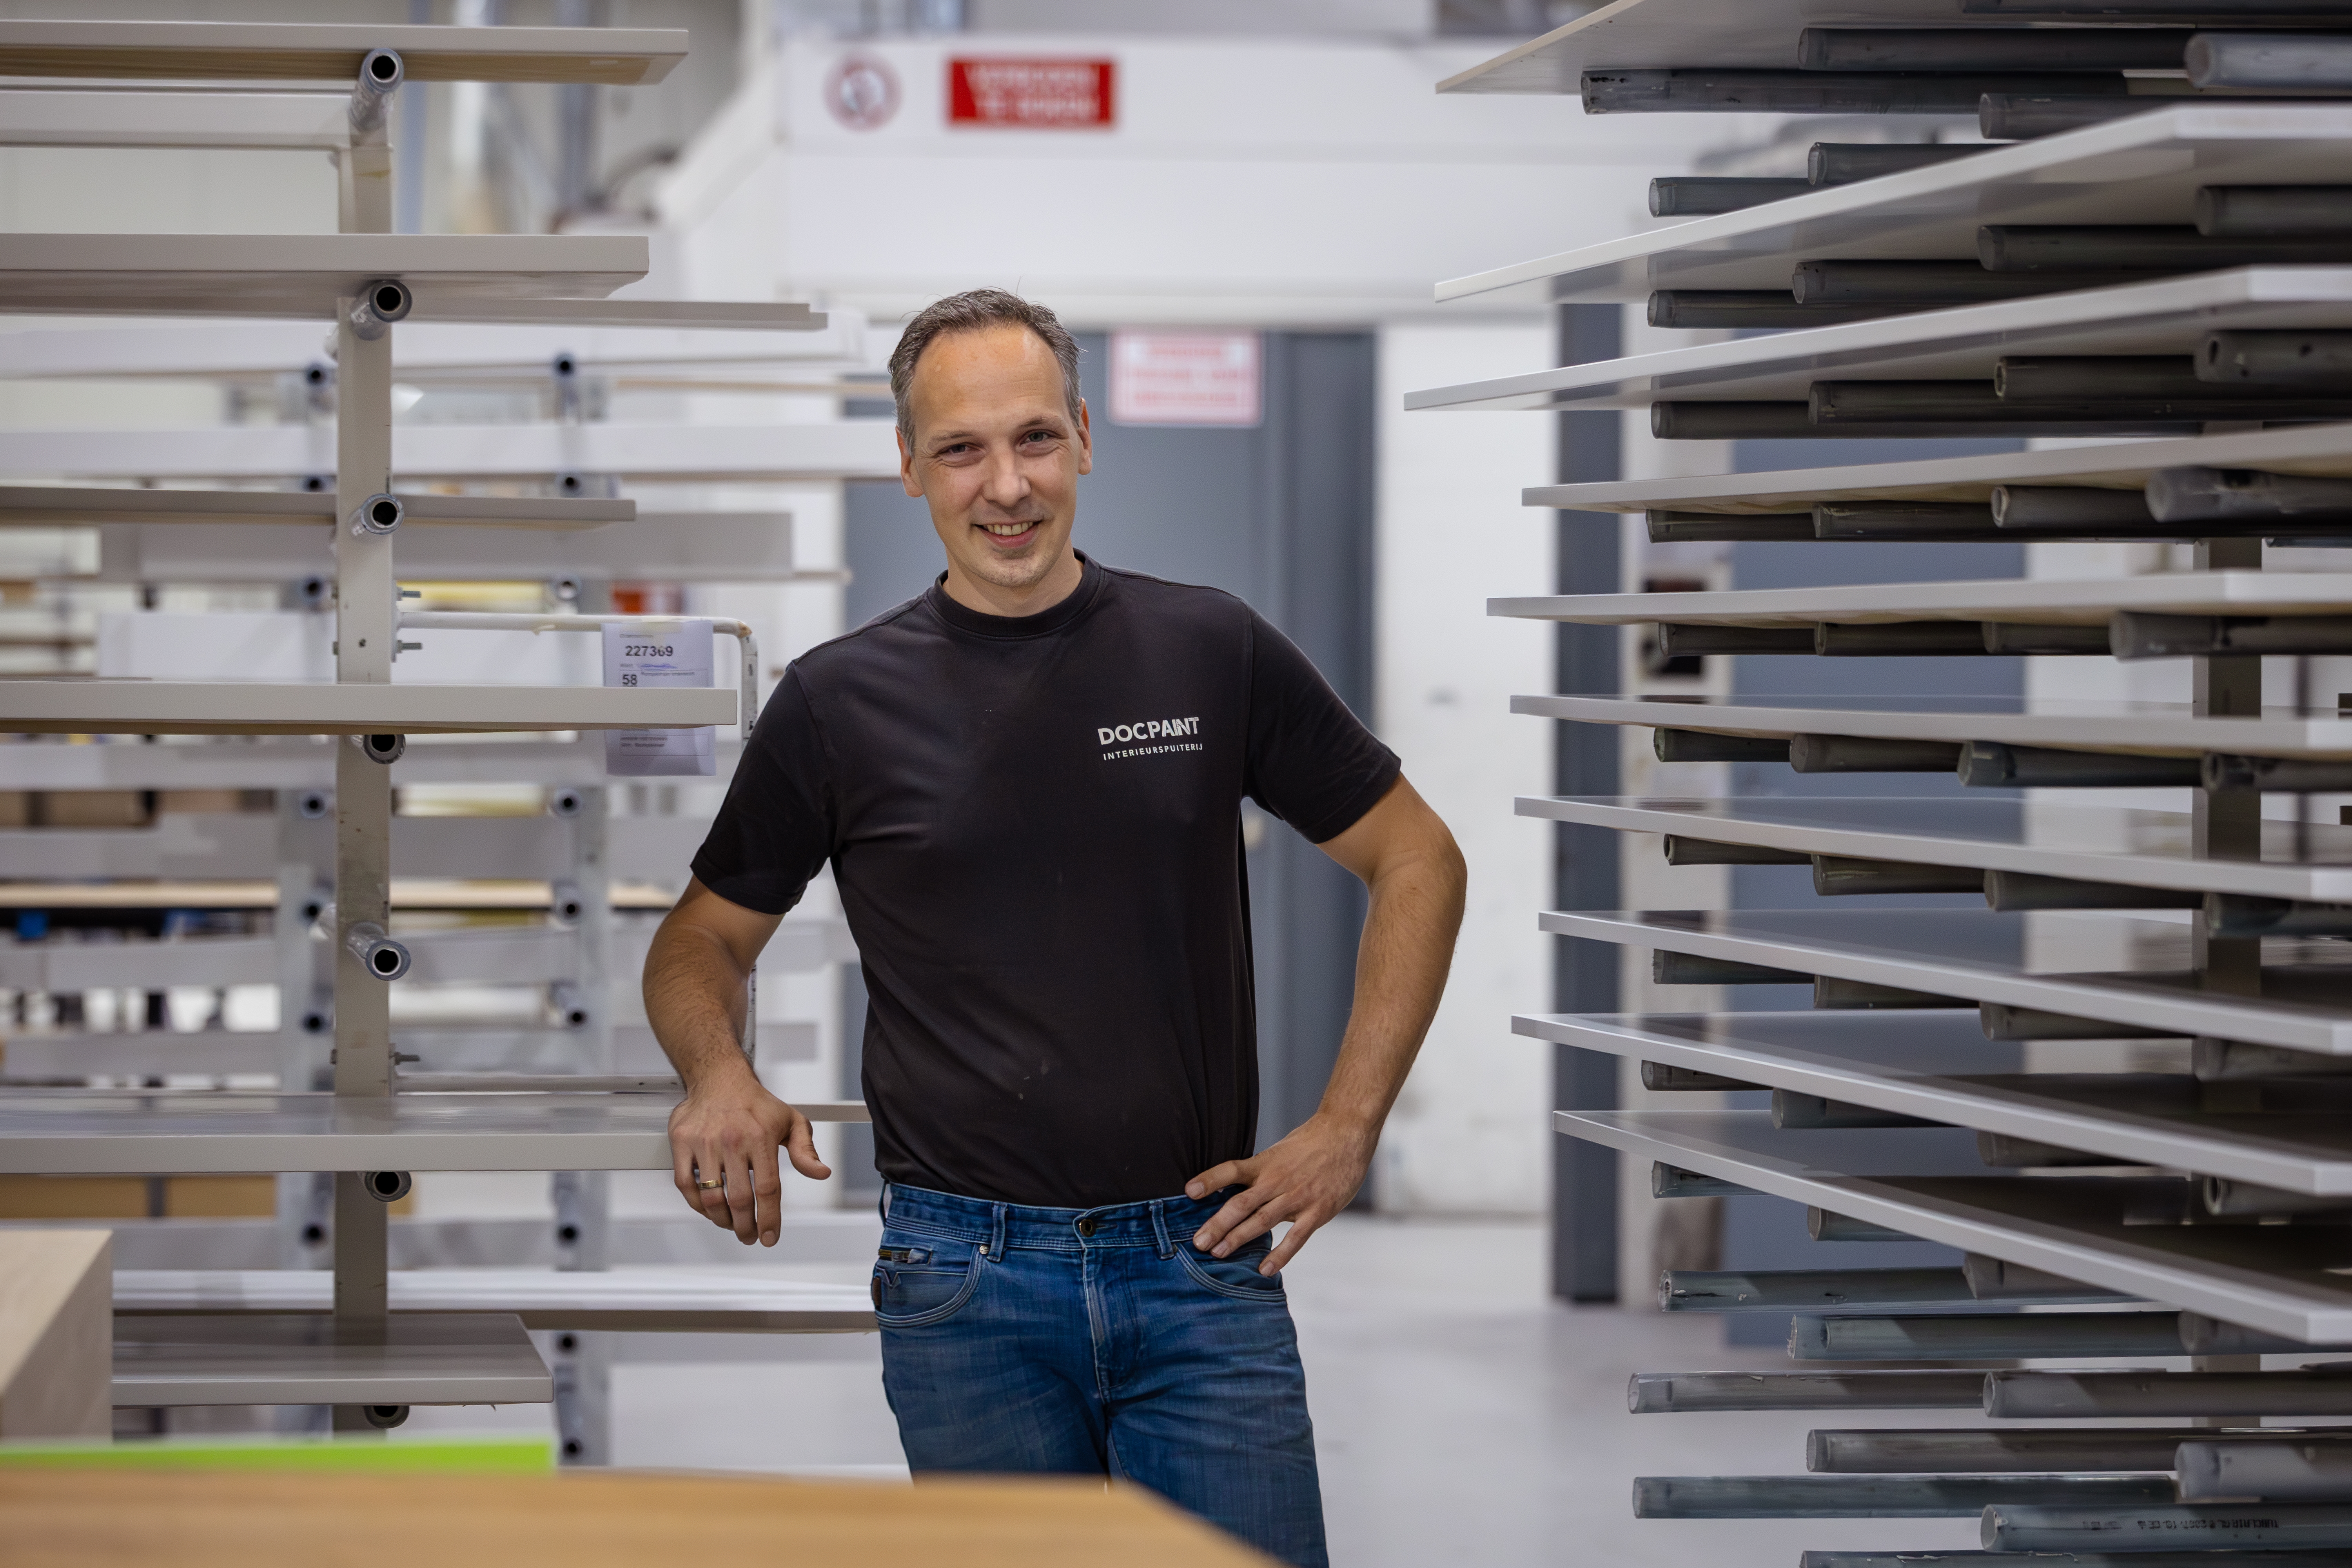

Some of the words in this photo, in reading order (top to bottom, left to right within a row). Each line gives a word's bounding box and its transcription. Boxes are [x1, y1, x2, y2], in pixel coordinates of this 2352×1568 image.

[625, 646, 673, 657] 227369
[622, 674, 637, 685] 58
[1098, 717, 1200, 745] DOCPAINT
[1103, 743, 1203, 760] INTERIEURSPUITERIJ
